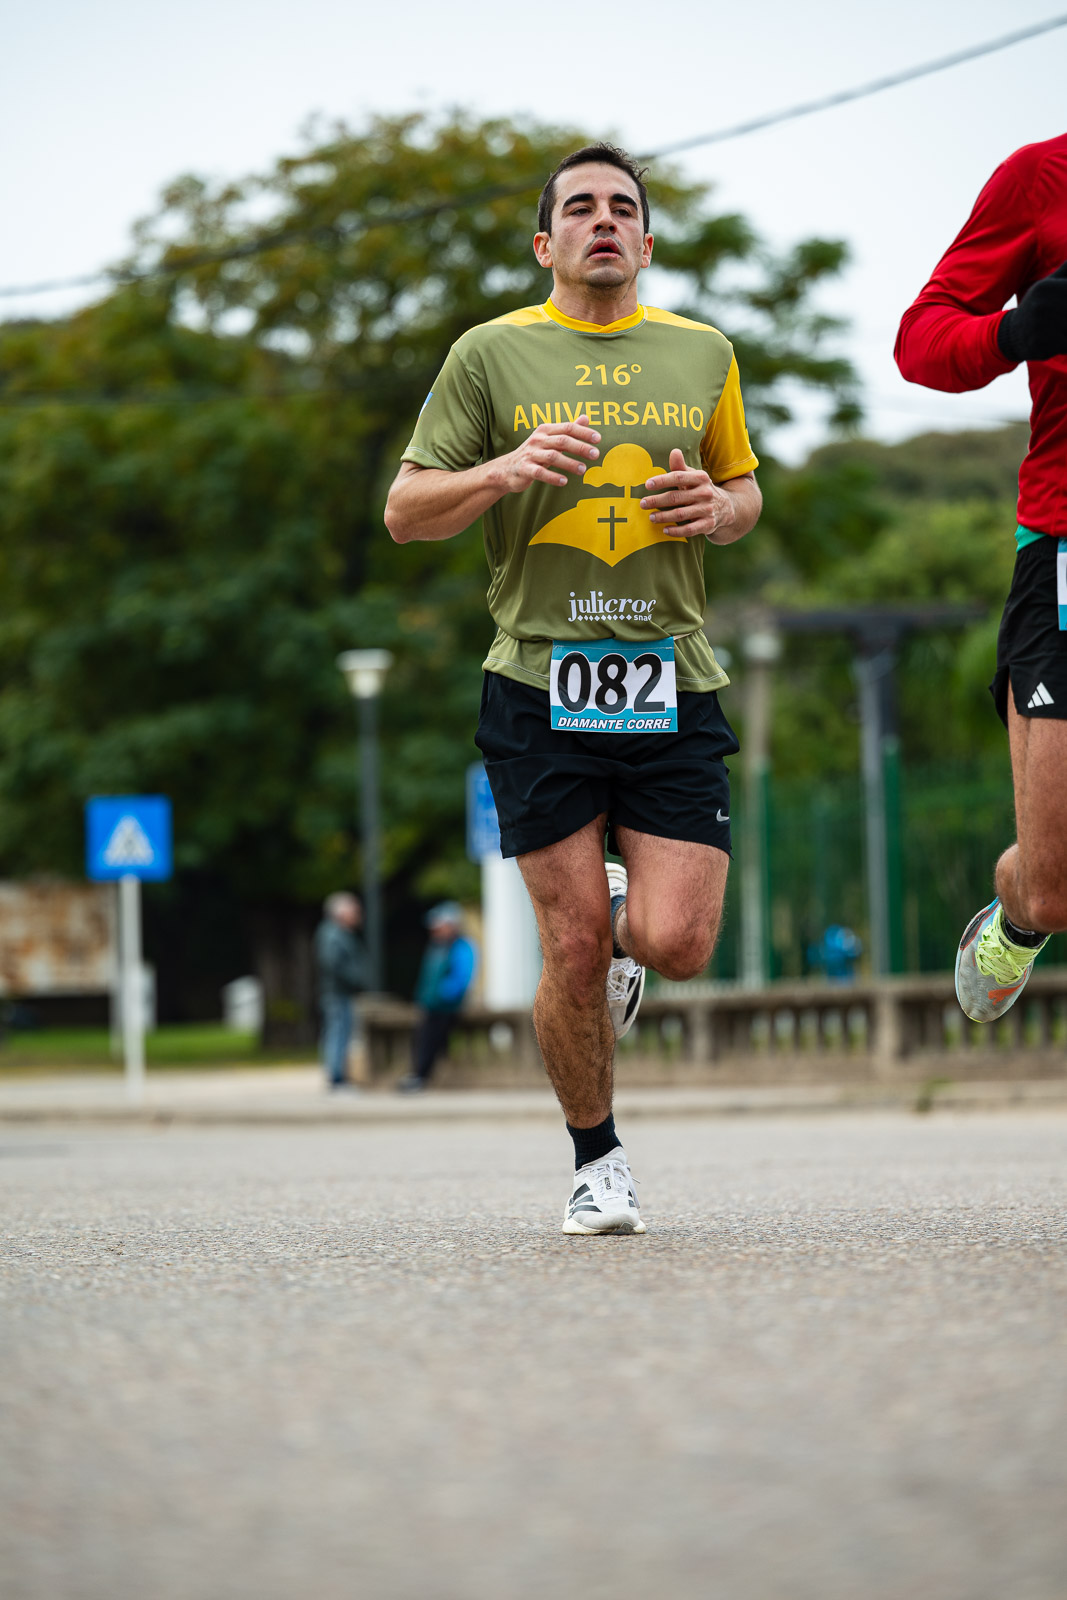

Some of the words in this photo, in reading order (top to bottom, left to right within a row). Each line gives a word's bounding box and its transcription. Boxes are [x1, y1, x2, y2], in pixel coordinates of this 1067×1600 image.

[575, 363, 642, 386] 216°
[513, 401, 704, 432] ANIVERSARIO
[557, 650, 667, 715] 082
[557, 717, 624, 730] DIAMANTE
[626, 718, 672, 730] CORRE
